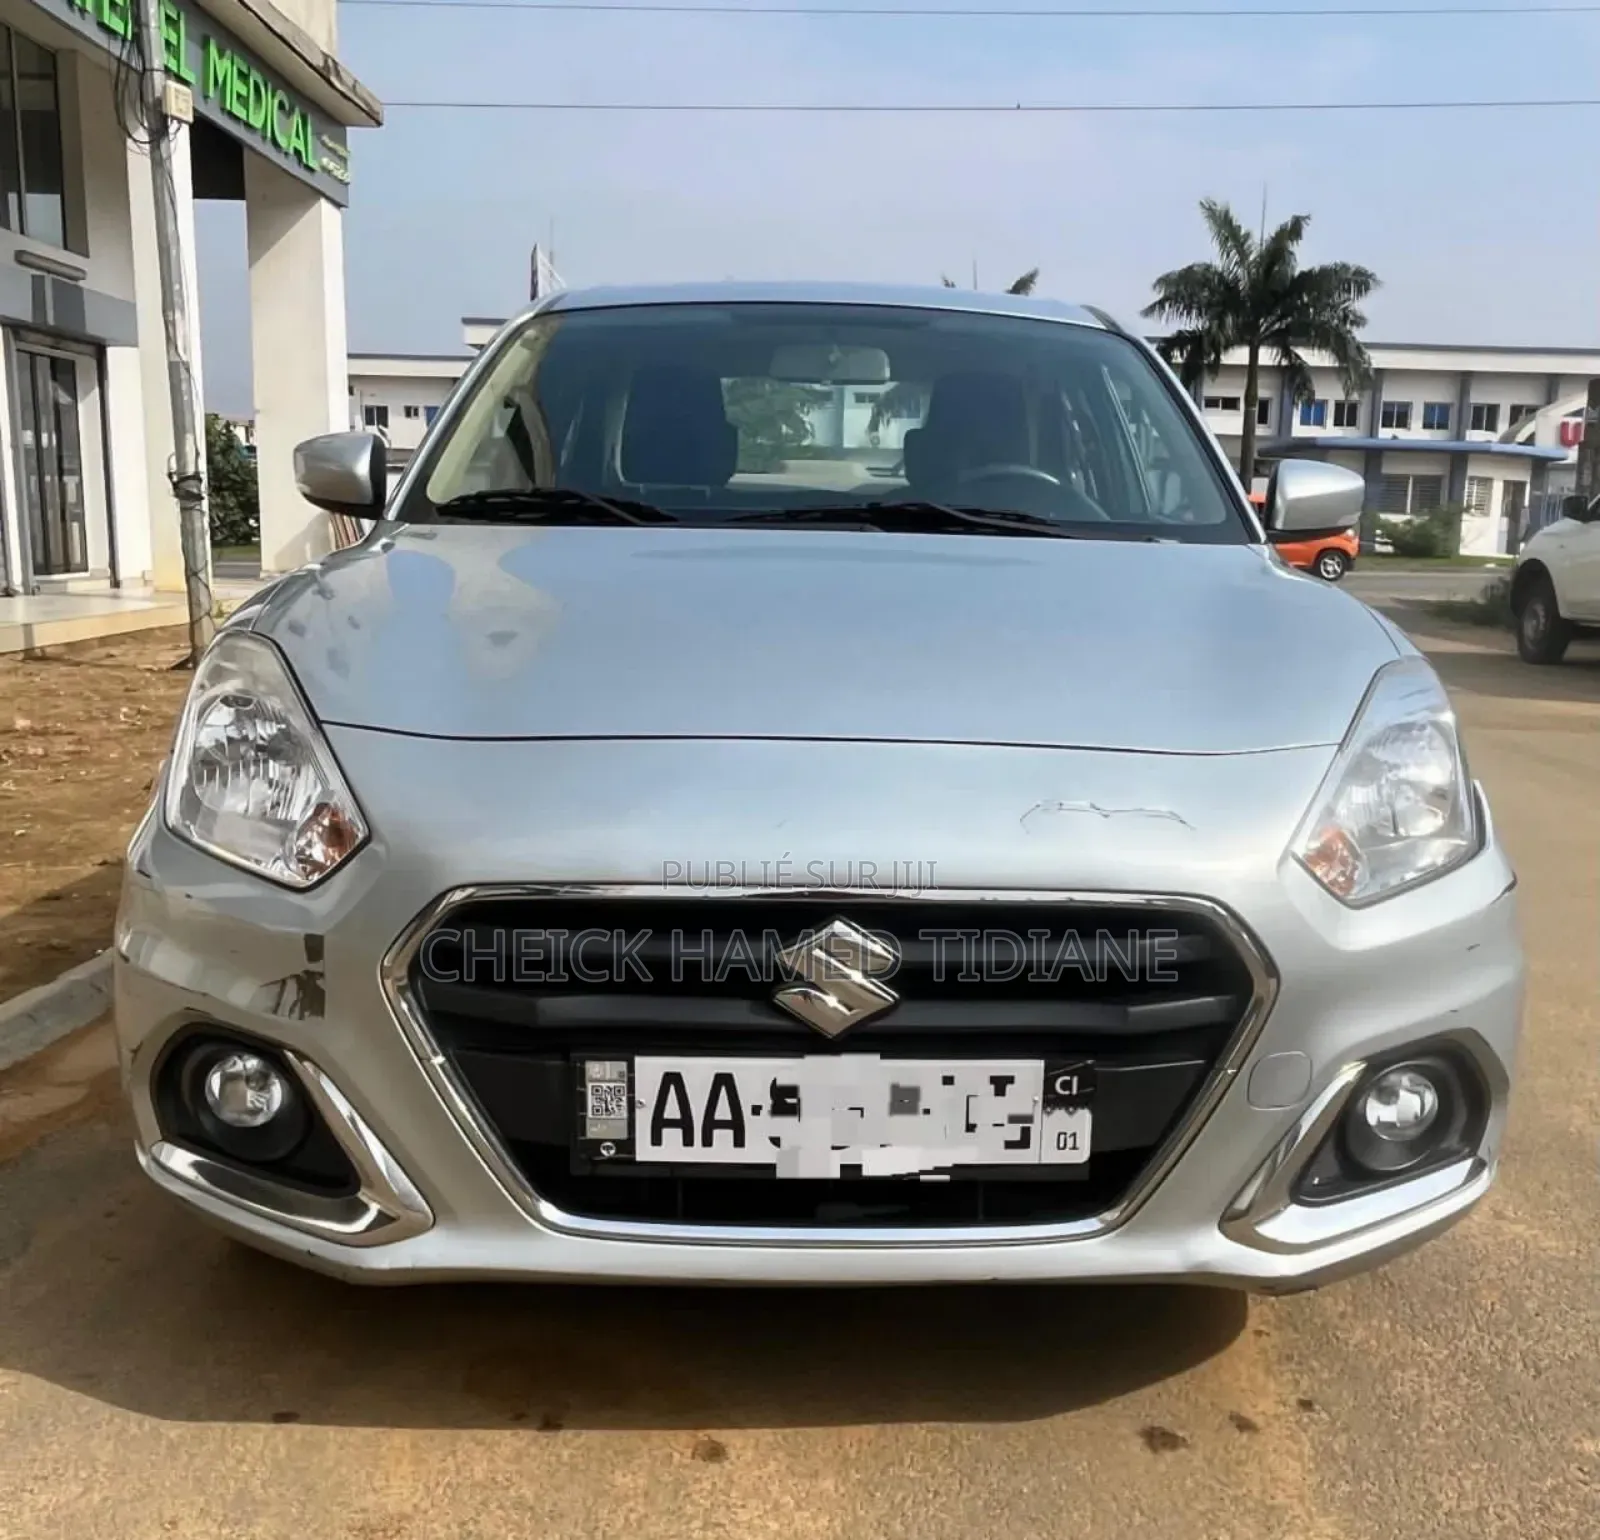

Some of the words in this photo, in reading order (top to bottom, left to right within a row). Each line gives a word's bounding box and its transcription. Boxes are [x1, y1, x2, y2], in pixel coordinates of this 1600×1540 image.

[202, 34, 320, 172] MEDICAL
[1055, 1075, 1078, 1095] CI
[1056, 1131, 1080, 1151] 01
